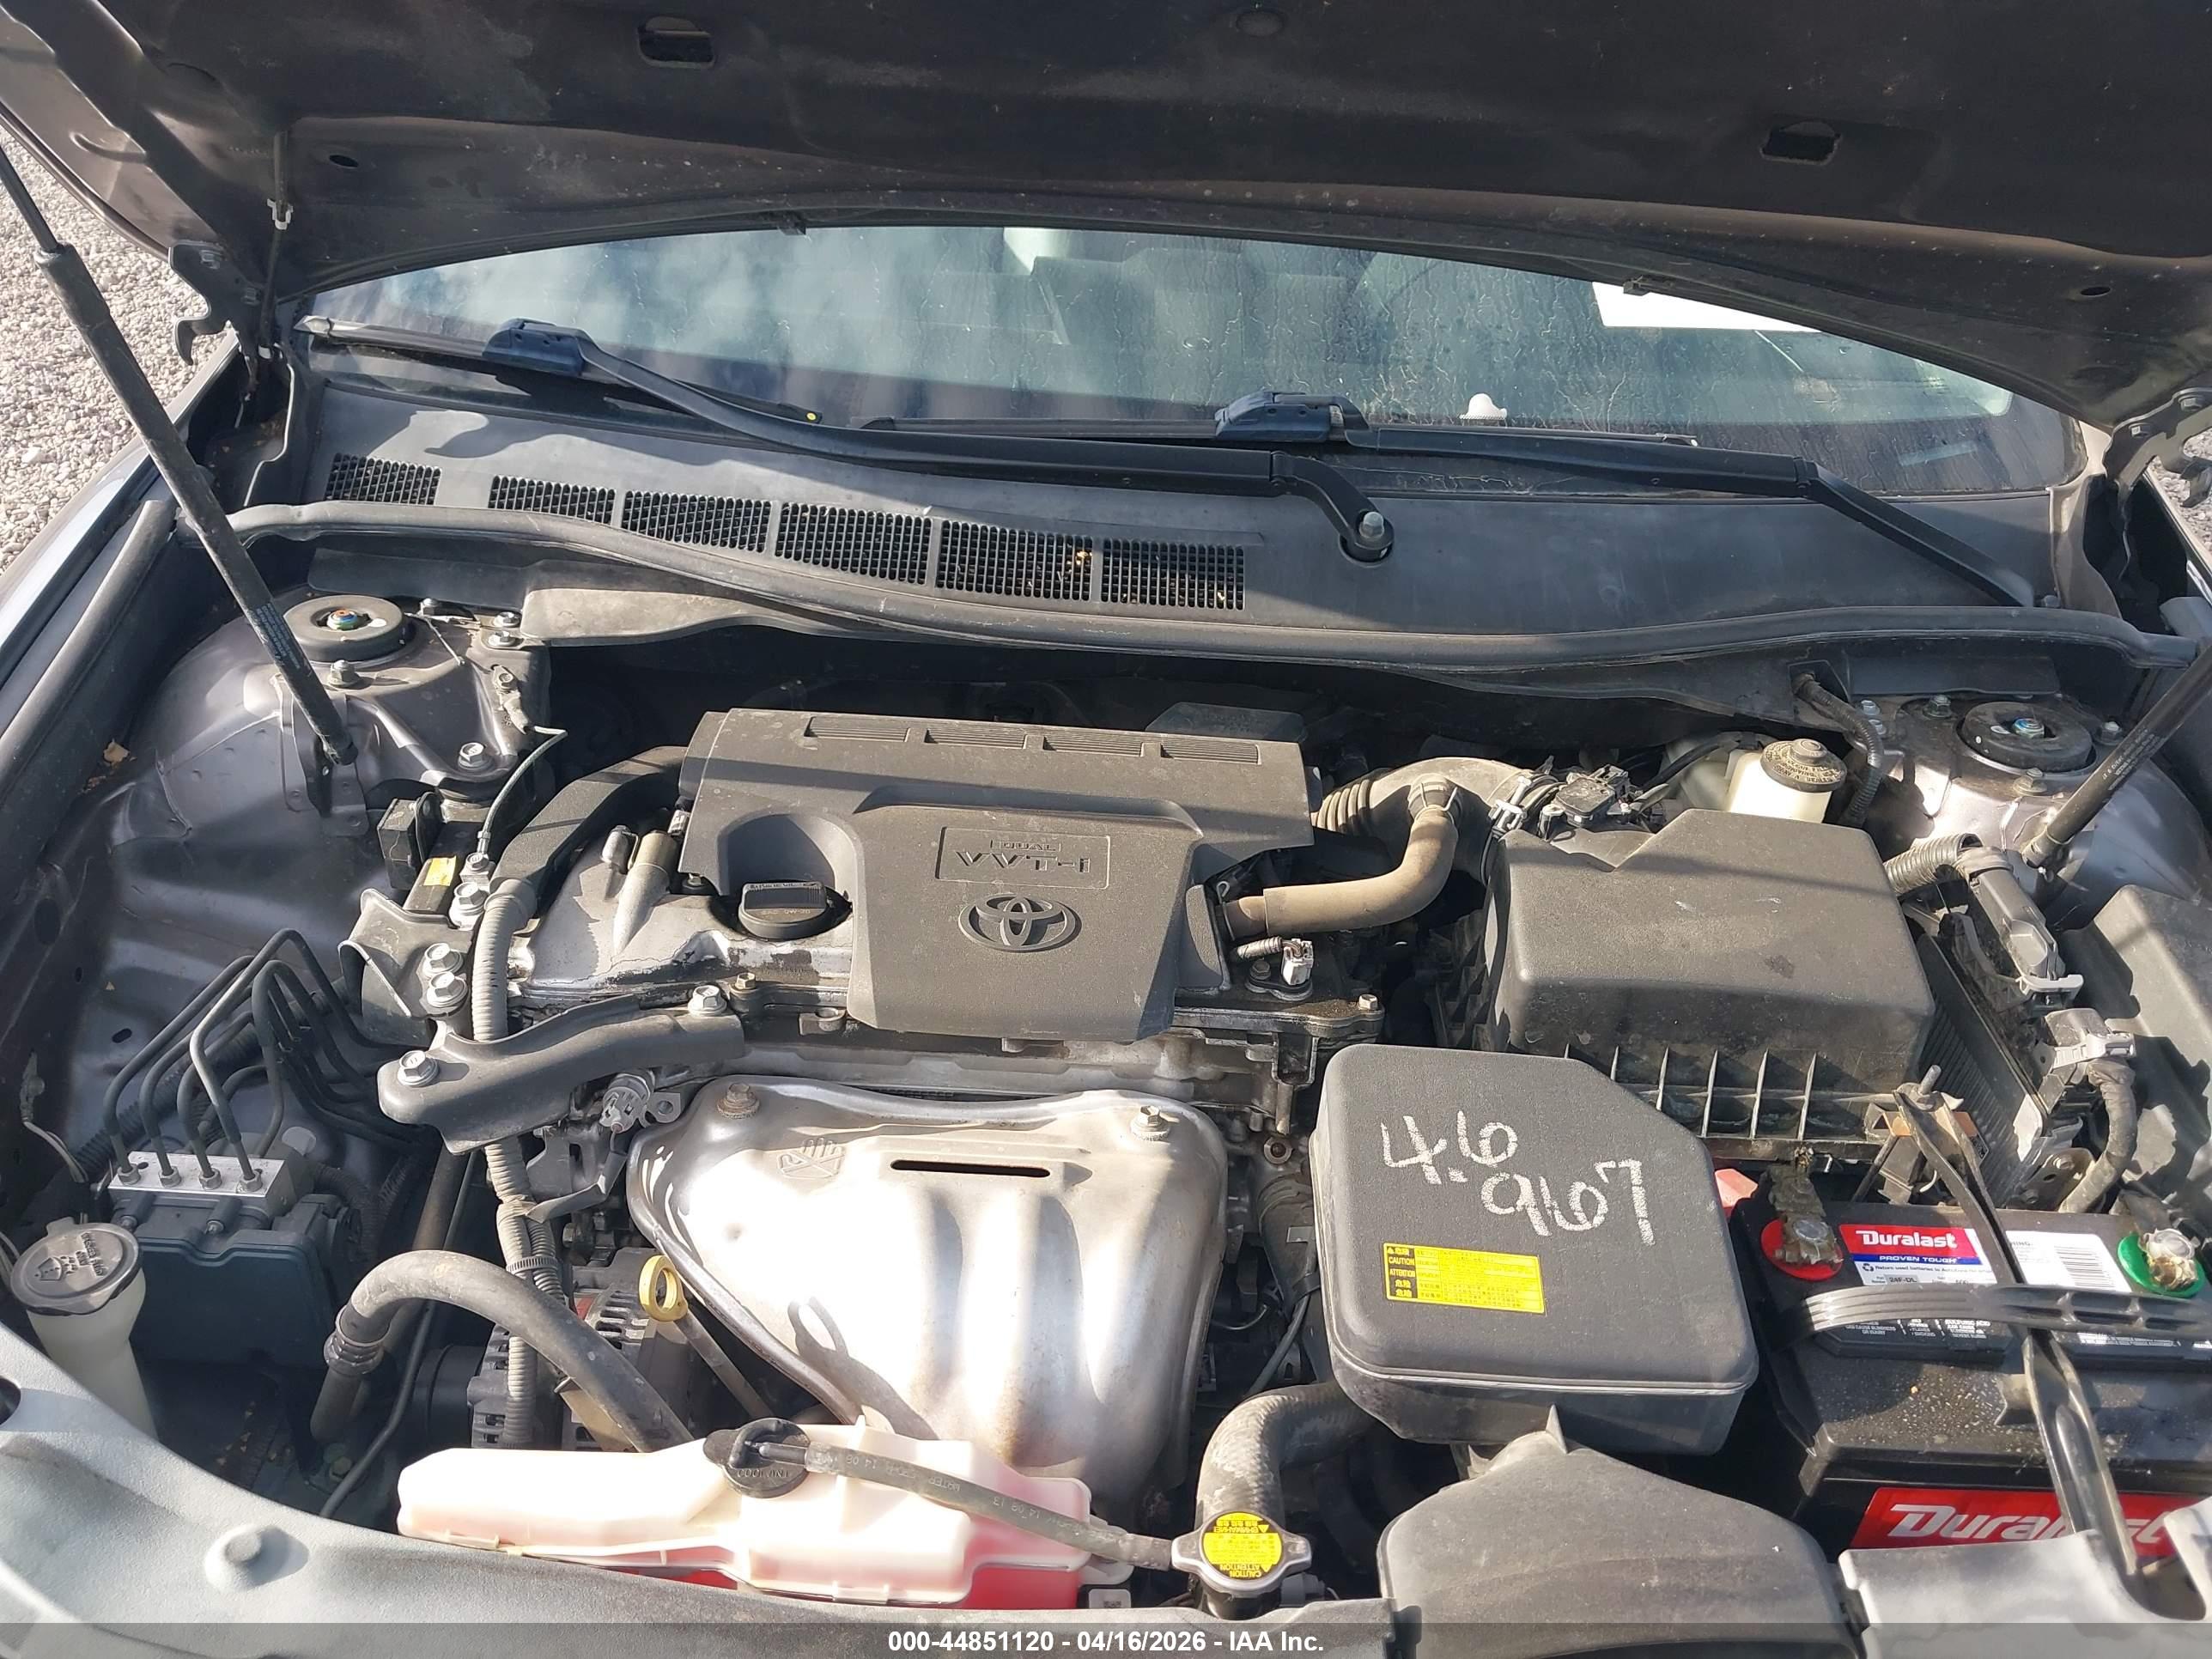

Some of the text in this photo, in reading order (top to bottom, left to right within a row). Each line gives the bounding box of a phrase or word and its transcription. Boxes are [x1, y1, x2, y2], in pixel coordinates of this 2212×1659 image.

[999, 840, 1057, 852] DUAL
[1380, 1109, 1519, 1185] 4.6
[1480, 1158, 1656, 1247] 967
[1856, 1230, 1958, 1249] Duralast
[1388, 1256, 1415, 1266] CAUTION
[1389, 1268, 1416, 1278] ATTENTION
